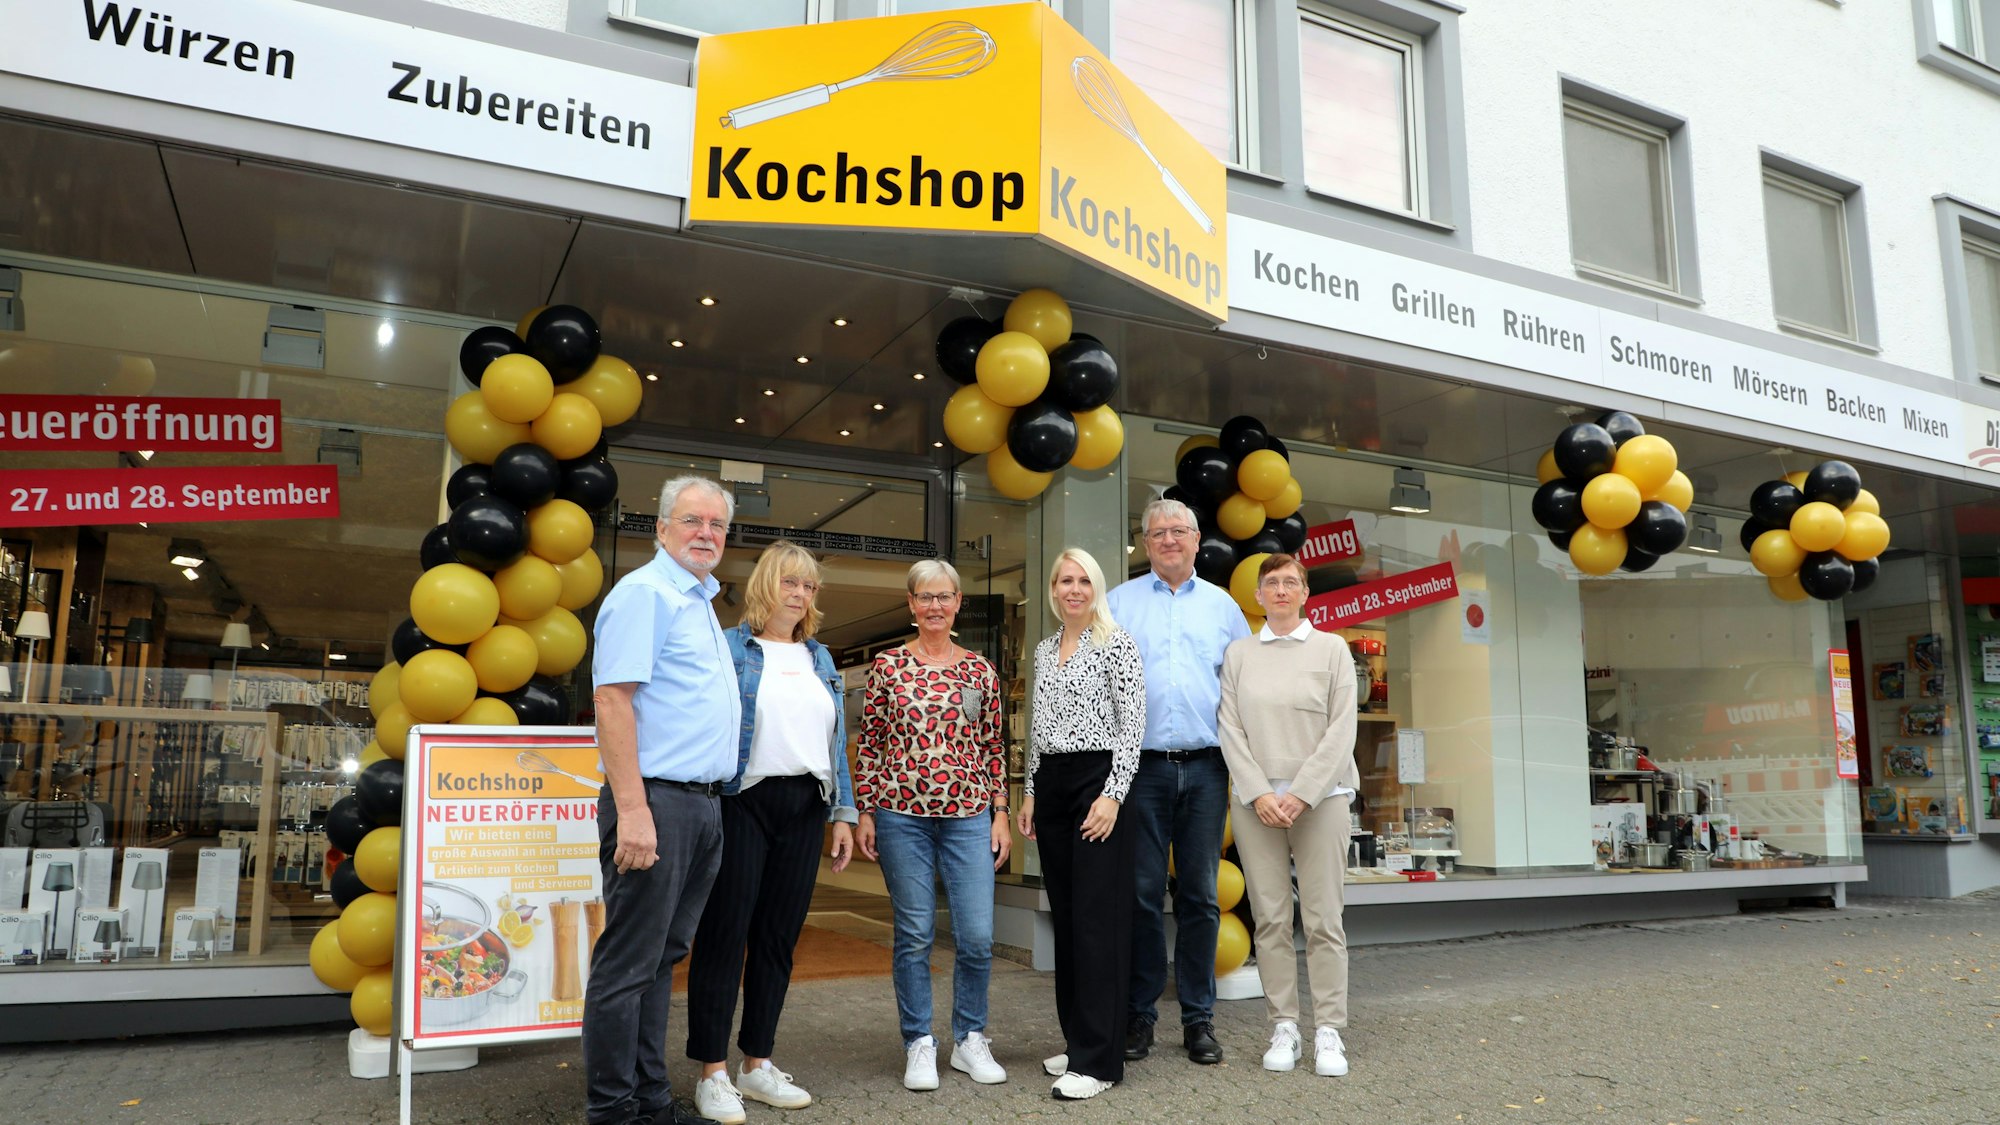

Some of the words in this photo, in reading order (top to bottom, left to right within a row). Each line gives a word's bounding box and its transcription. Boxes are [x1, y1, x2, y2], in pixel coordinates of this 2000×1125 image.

[84, 0, 295, 79] Würzen
[387, 61, 653, 150] Zubereiten
[706, 146, 1025, 221] Kochshop
[1050, 166, 1222, 304] Kochshop
[1254, 249, 1360, 301] Kochen
[1391, 282, 1476, 328] Grillen
[1502, 308, 1585, 354] Rühren
[1609, 335, 1713, 383] Schmoren
[1732, 365, 1808, 406] Mörsern
[1825, 387, 1887, 424] Backen
[1902, 407, 1949, 439] Mixen
[0, 403, 275, 449] ueröffnung
[10, 487, 58, 512] 27.
[65, 486, 120, 511] und
[129, 485, 176, 509] 28.
[182, 482, 331, 511] September
[1295, 529, 1357, 562] nung
[1310, 605, 1334, 626] 27.
[1334, 597, 1361, 619] und
[1362, 592, 1385, 612] 28.
[1385, 576, 1453, 604] September
[437, 772, 544, 794] Kochshop
[450, 829, 474, 841] Wir
[479, 829, 521, 841] bieten
[525, 829, 552, 840] eine
[431, 847, 467, 860] große
[470, 846, 519, 858] Auswahl
[522, 847, 536, 857] an
[438, 864, 485, 876] Artikeln
[488, 866, 511, 875] zum
[514, 863, 555, 874] Kochen
[514, 879, 535, 890] und
[538, 878, 591, 889] Servieren
[1, 915, 20, 924] cilio
[81, 914, 99, 922] cilio
[176, 913, 193, 921] cilio
[543, 1005, 553, 1017] &
